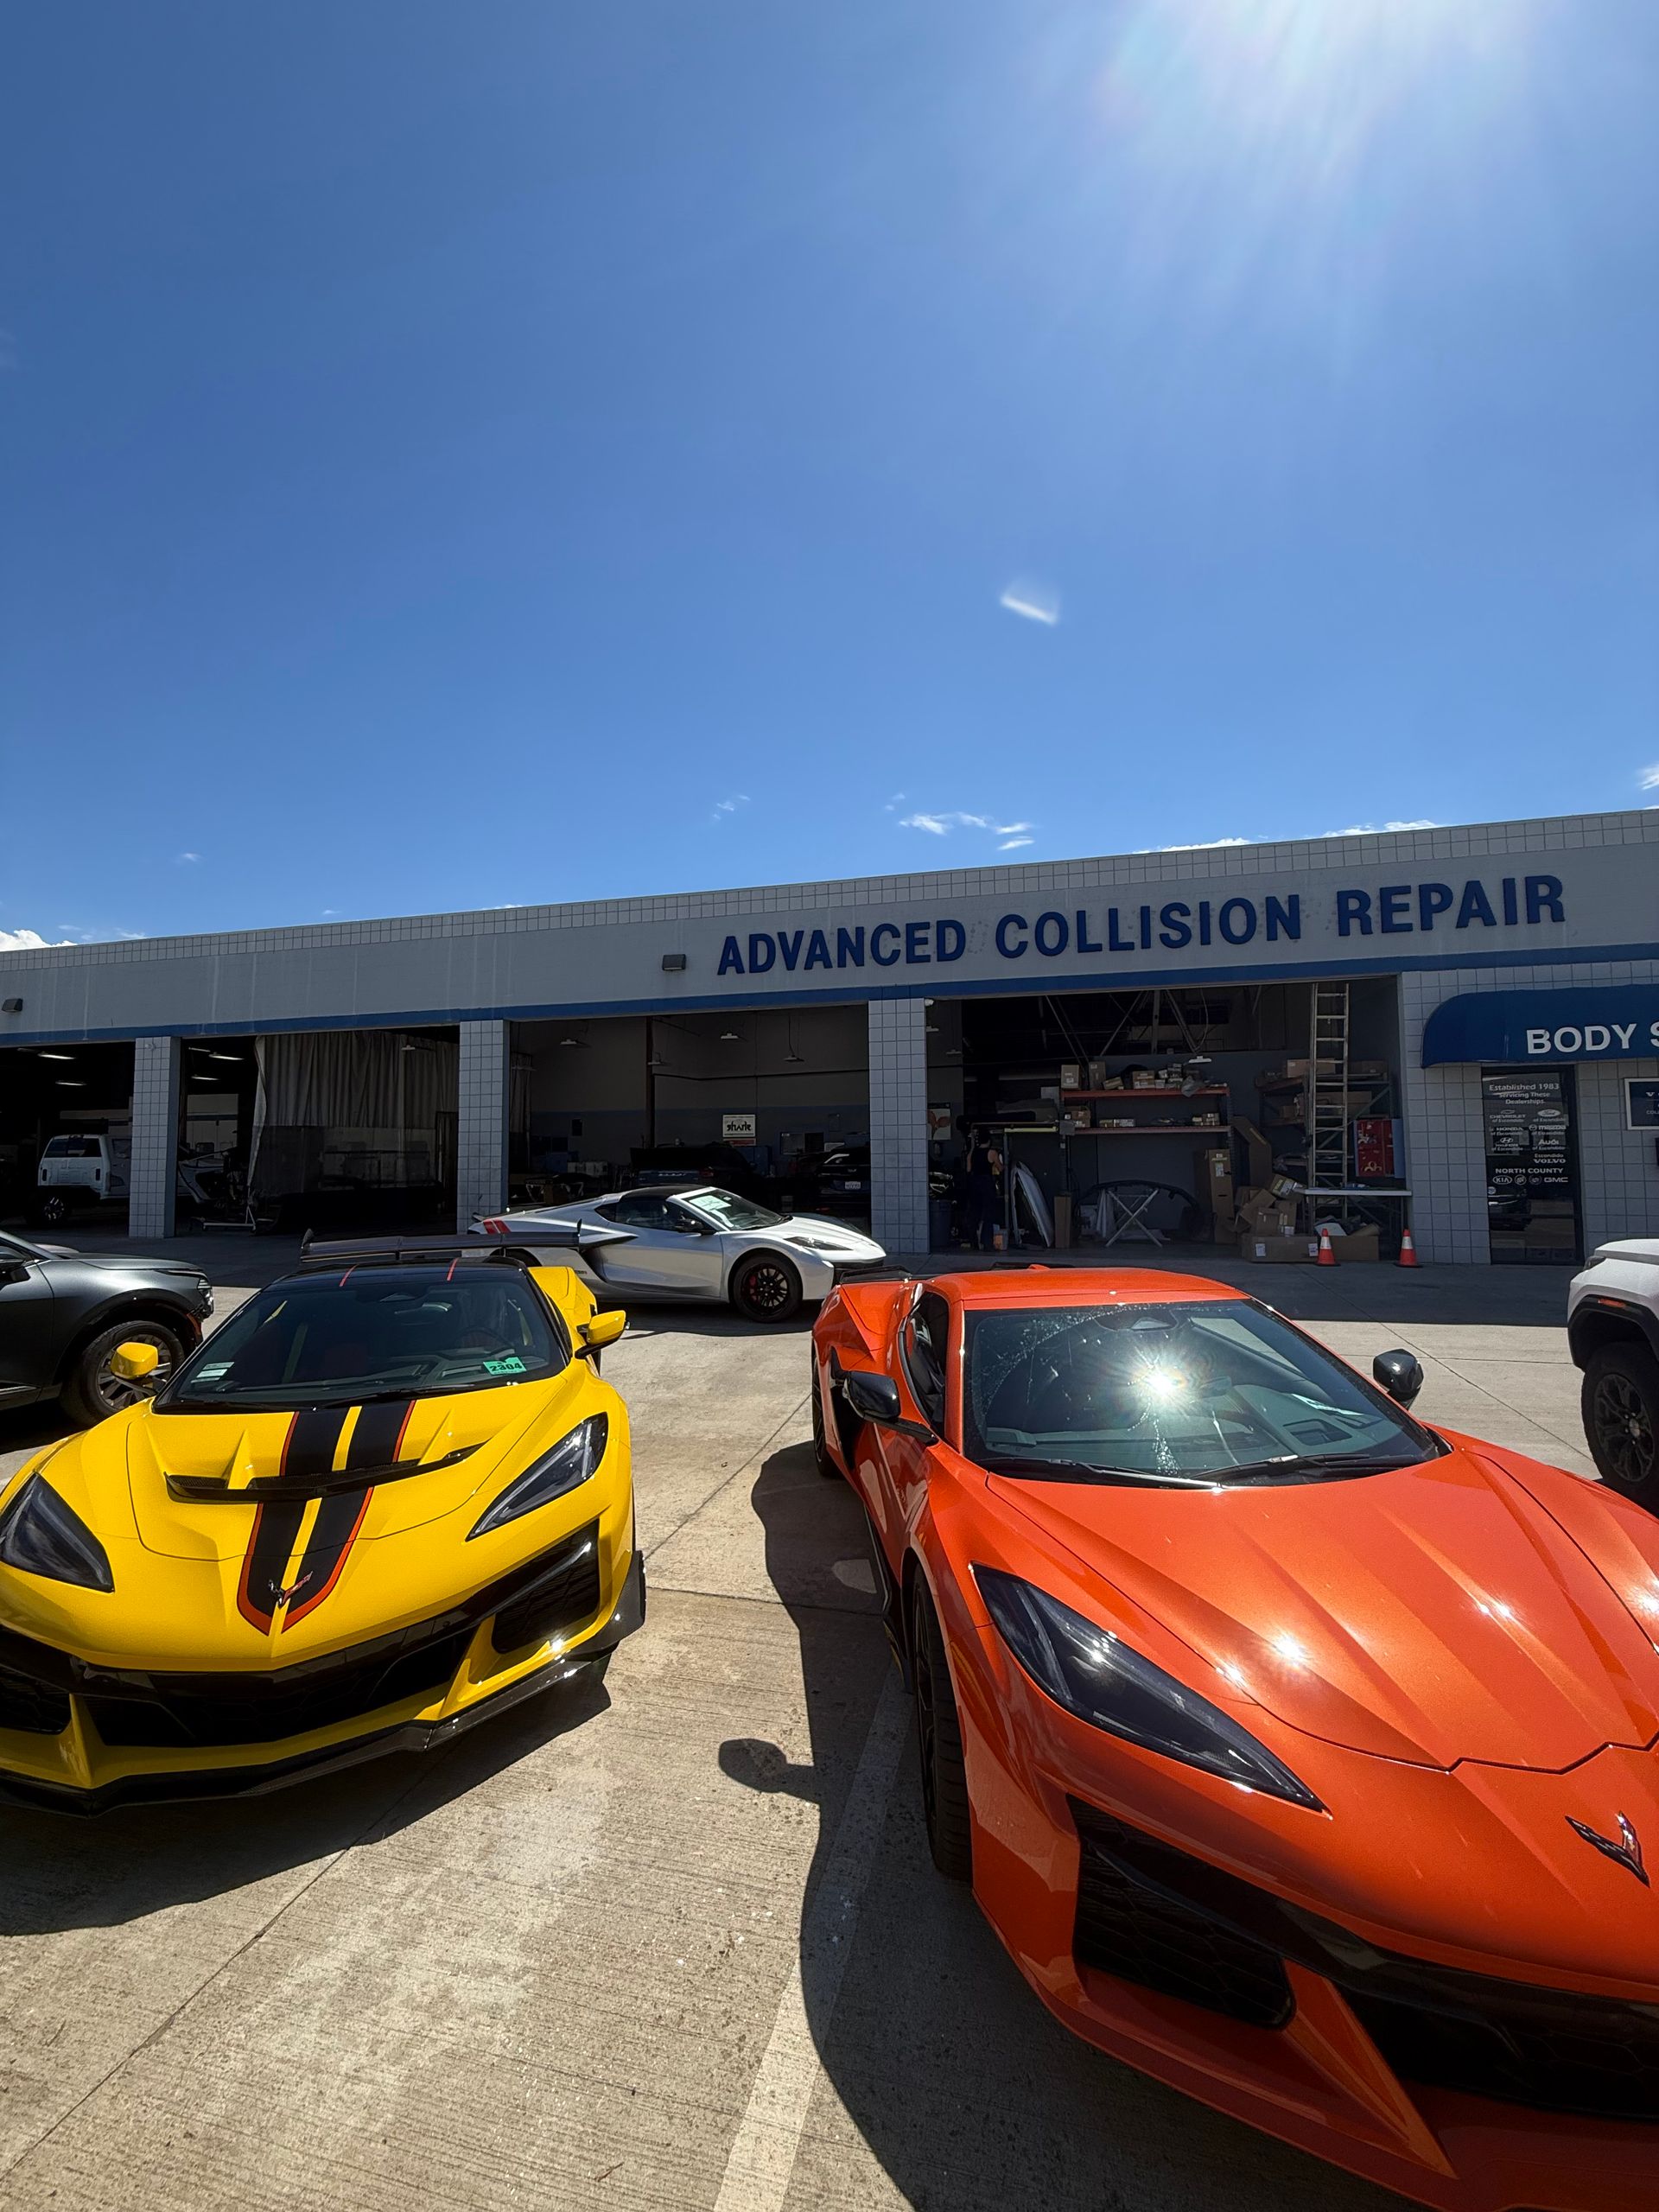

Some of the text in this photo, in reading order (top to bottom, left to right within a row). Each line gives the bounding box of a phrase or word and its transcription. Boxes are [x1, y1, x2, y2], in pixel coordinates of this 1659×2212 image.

[718, 874, 1567, 976] ADVANCED COLLISION REPAIR
[1526, 1023, 1637, 1054] BODY
[489, 1363, 523, 1371] 2304
